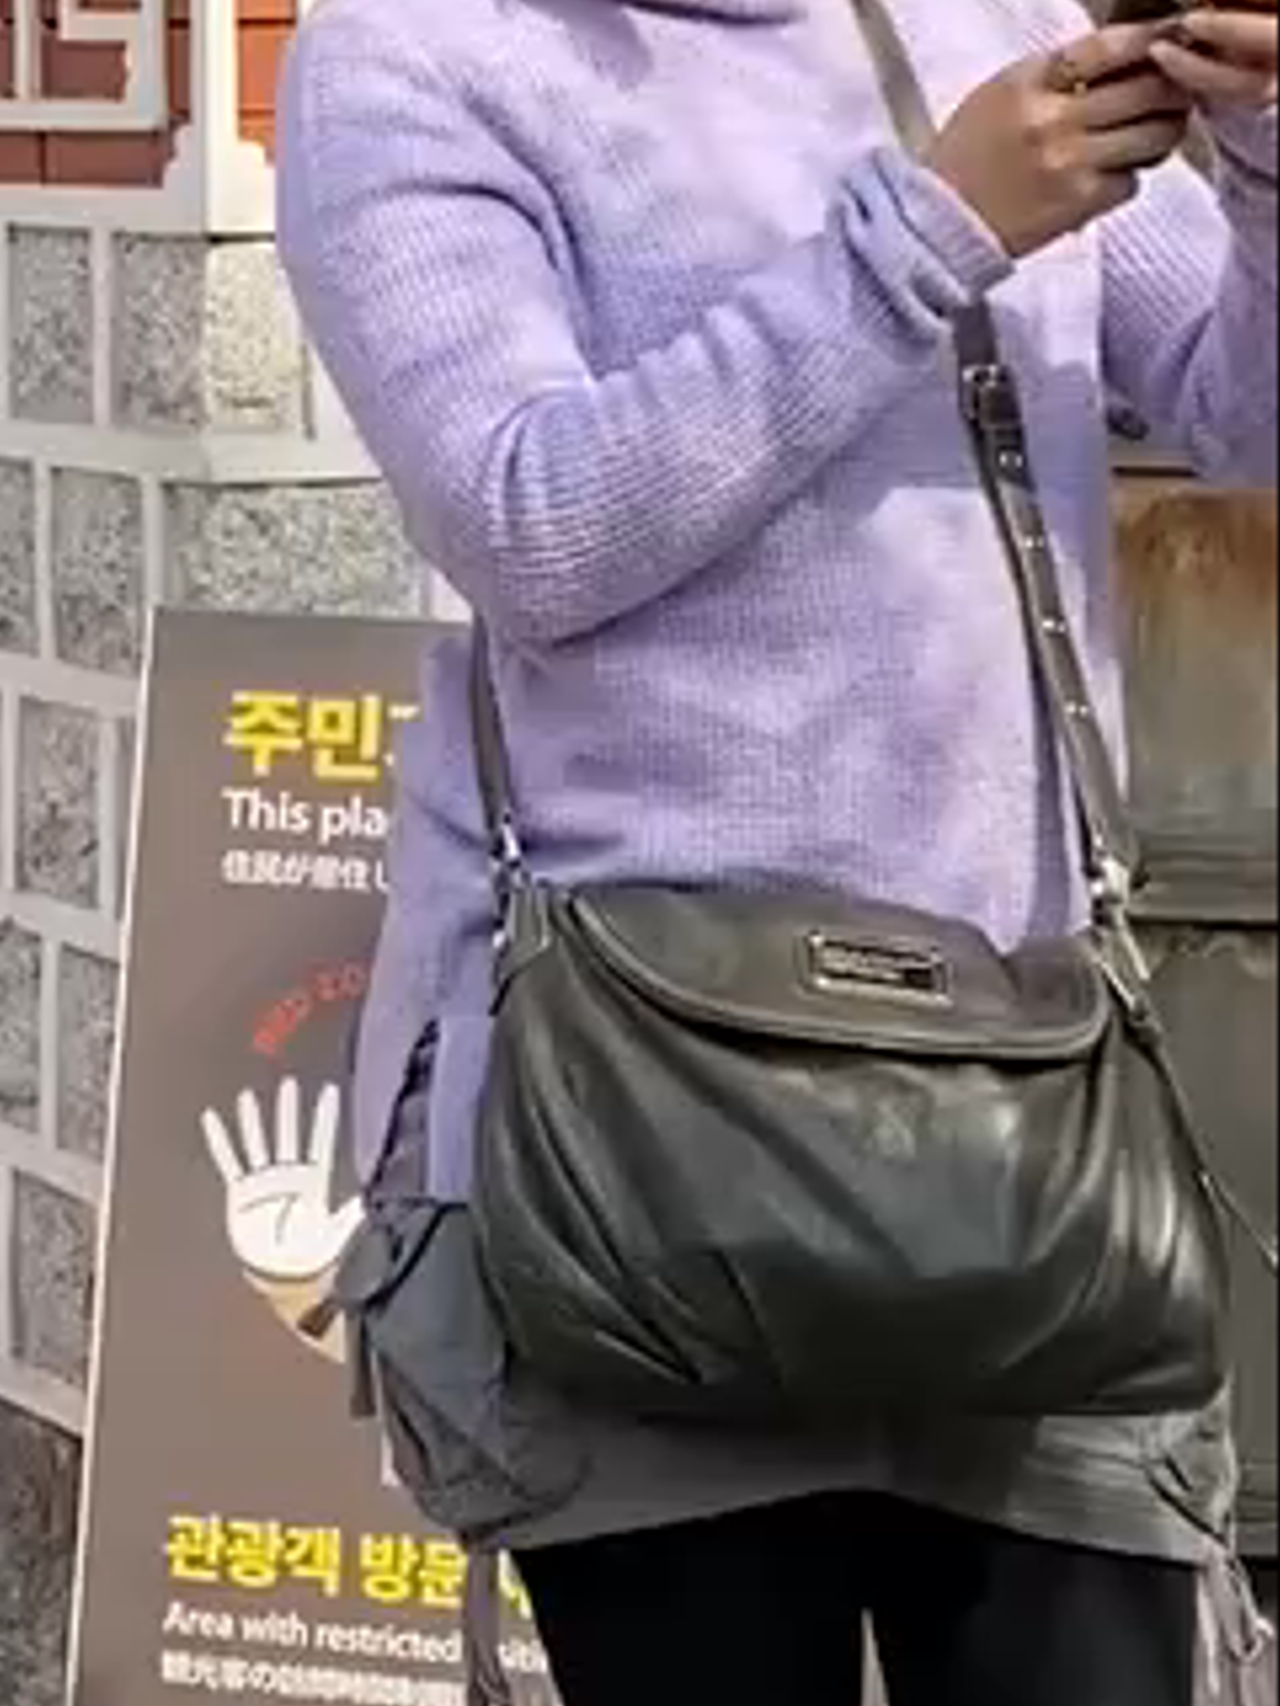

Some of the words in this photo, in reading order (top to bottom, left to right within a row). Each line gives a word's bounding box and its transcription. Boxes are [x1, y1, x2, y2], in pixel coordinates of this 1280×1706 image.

[222, 690, 420, 779] 주민
[220, 788, 311, 833] This
[318, 794, 390, 846] pla
[166, 1514, 341, 1597] 관광객
[162, 1601, 234, 1638] Area
[241, 1612, 308, 1648] with
[315, 1622, 462, 1664] restricted
